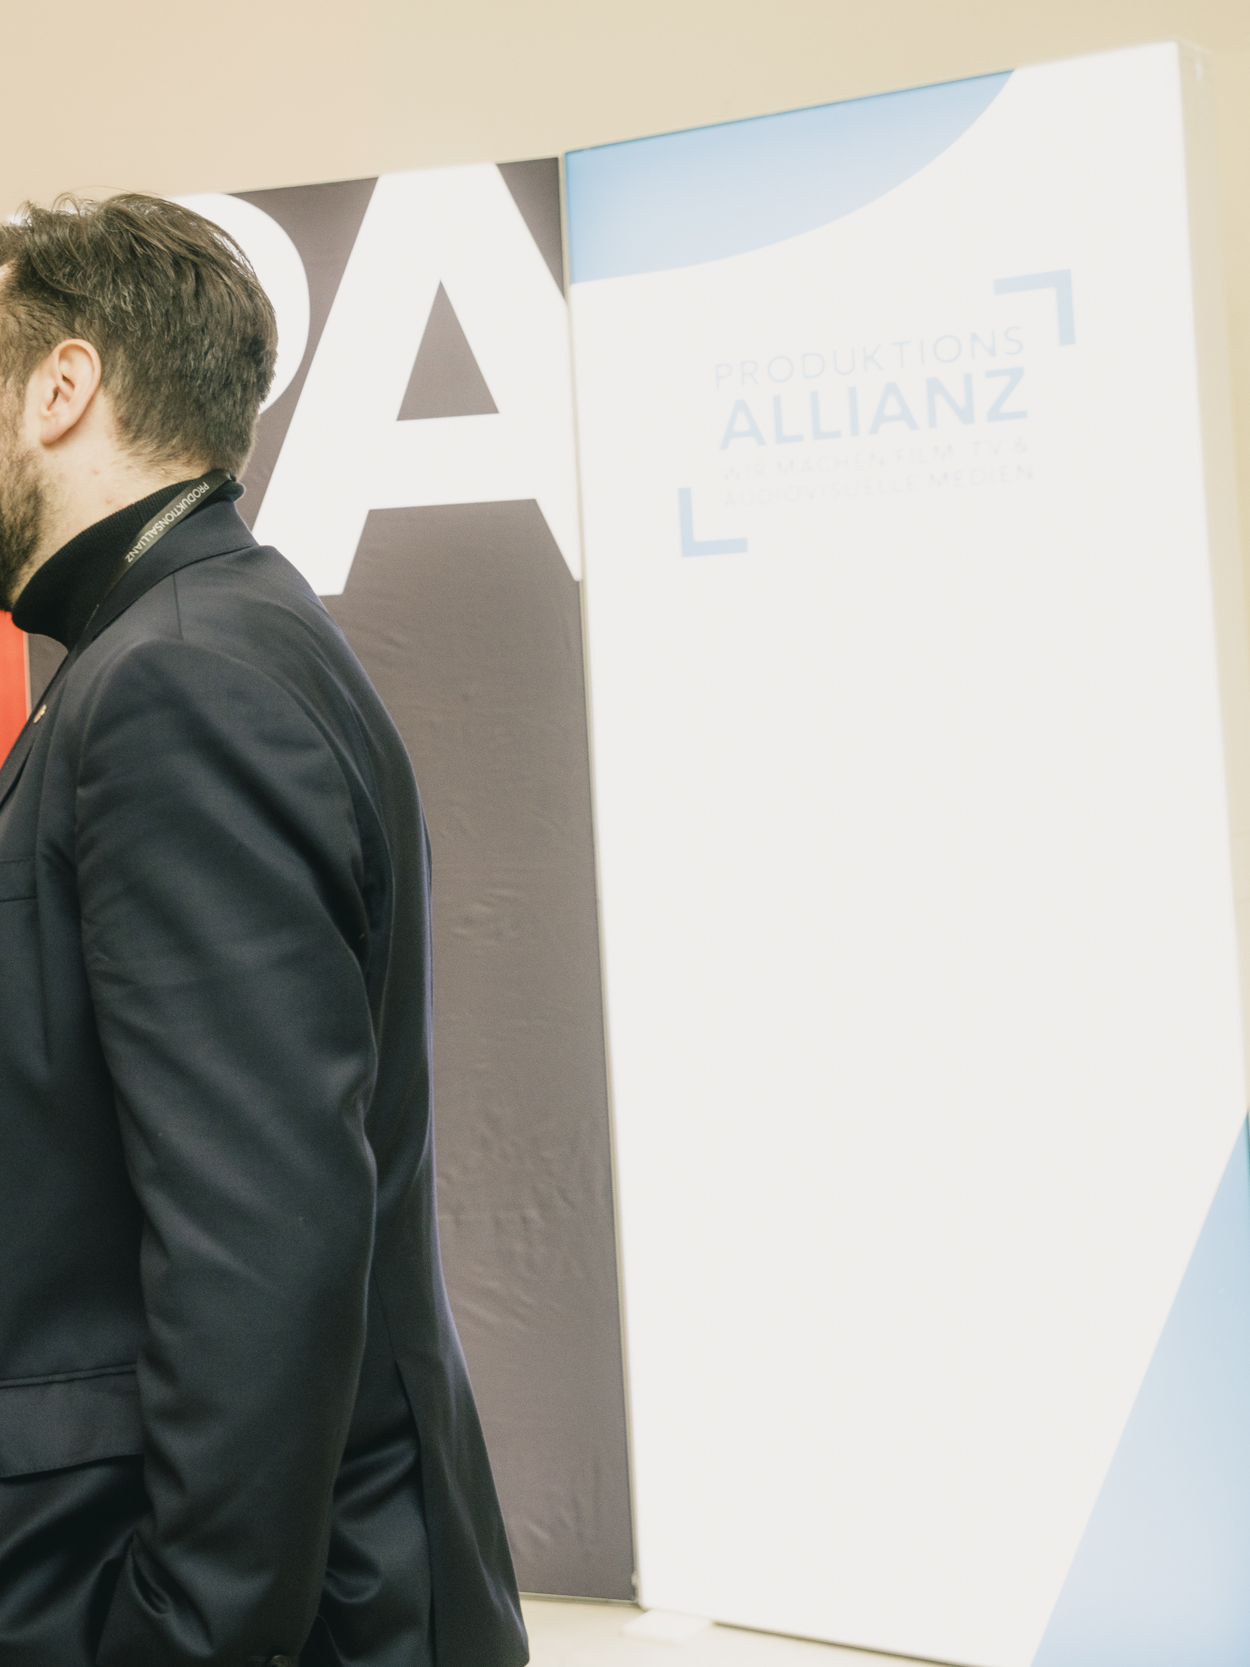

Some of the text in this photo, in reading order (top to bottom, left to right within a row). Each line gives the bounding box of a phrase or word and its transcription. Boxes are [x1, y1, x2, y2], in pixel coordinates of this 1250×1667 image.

[150, 160, 582, 597] A
[716, 326, 1025, 388] PRODUKTIONS
[718, 366, 1029, 451] ALLIANZ
[723, 464, 1034, 508] AUDIOVISUELLE MEDIEN
[776, 451, 887, 475] MACHEN
[972, 438, 1003, 458] TV
[124, 481, 210, 563] PRODUKTIONSALLIANZ
